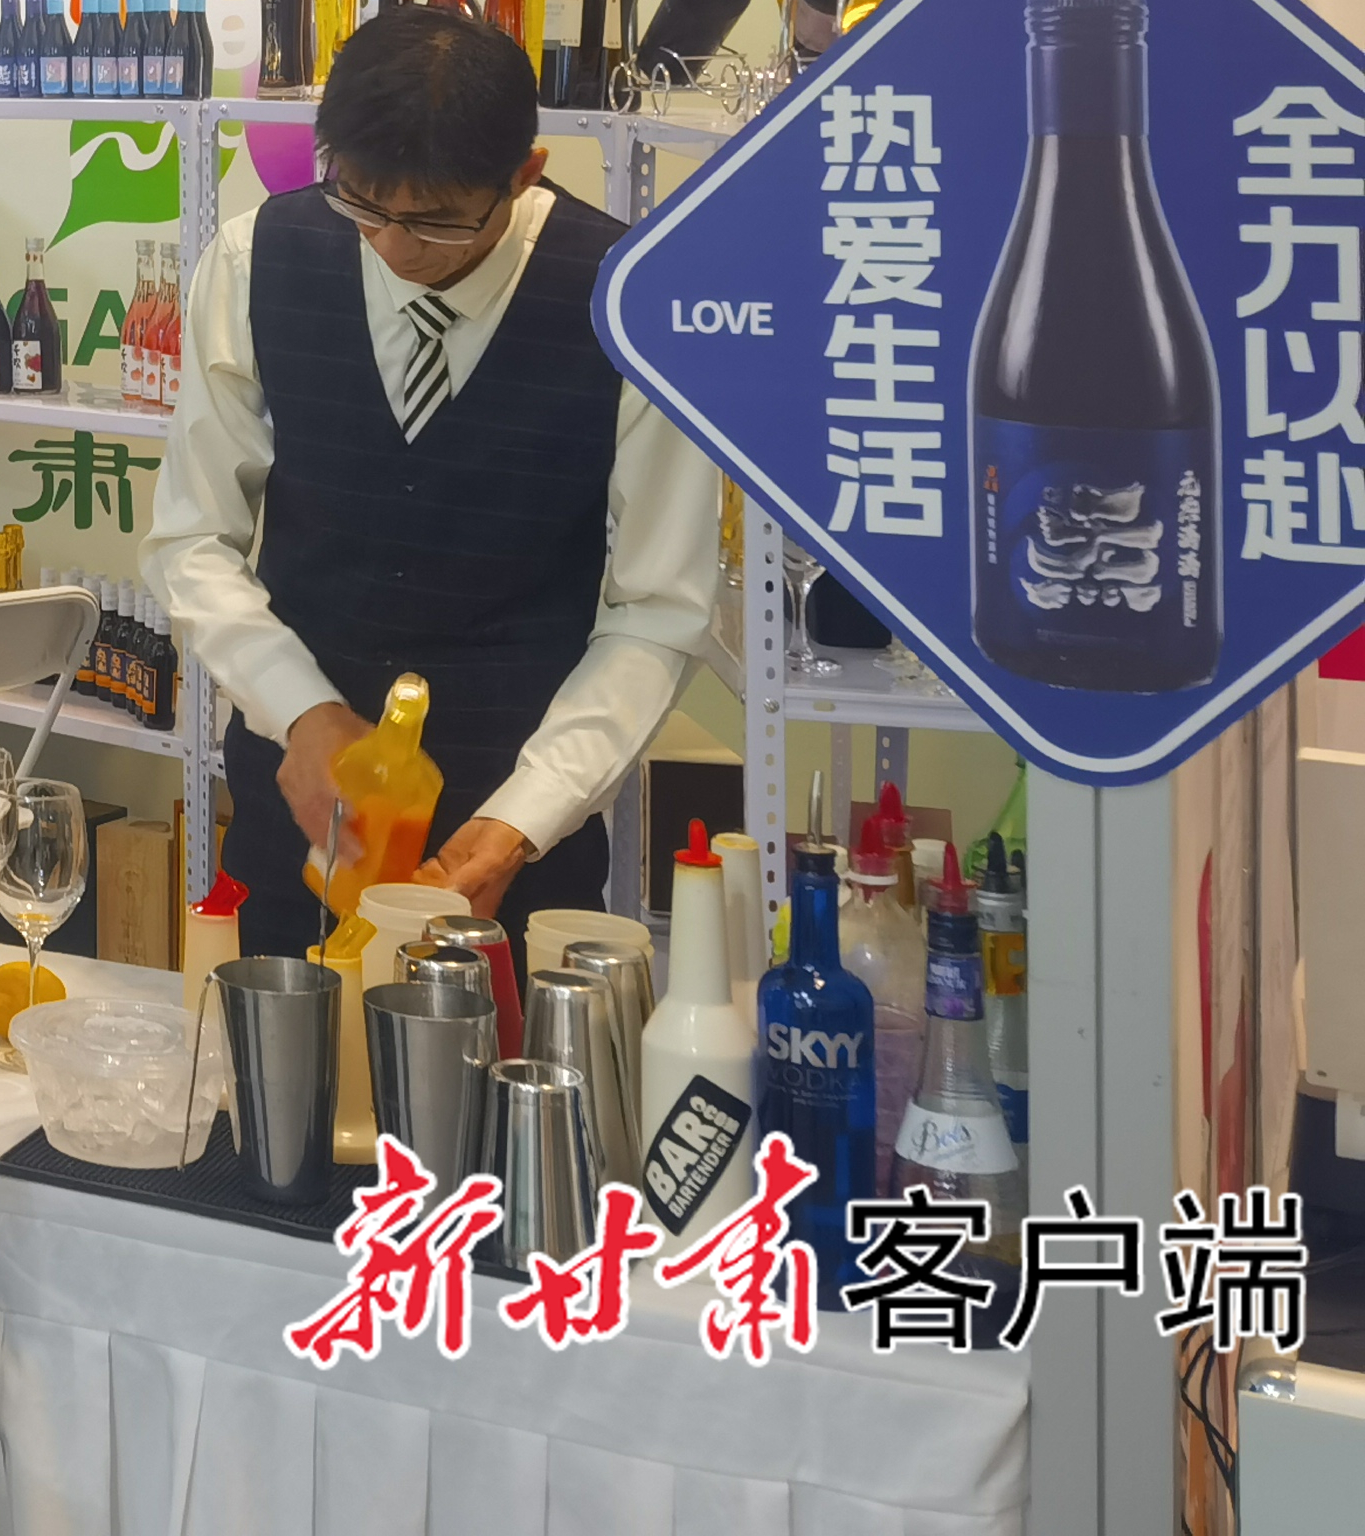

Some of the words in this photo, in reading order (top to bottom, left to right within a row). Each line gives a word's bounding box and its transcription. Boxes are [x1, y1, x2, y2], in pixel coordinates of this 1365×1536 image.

[670, 299, 775, 337] LOVE
[820, 84, 946, 539] 热爱生活
[1231, 85, 1365, 567] 全力以赴
[768, 1022, 864, 1069] SKYY
[645, 1110, 718, 1205] BAR
[668, 1132, 734, 1219] BARTENDER
